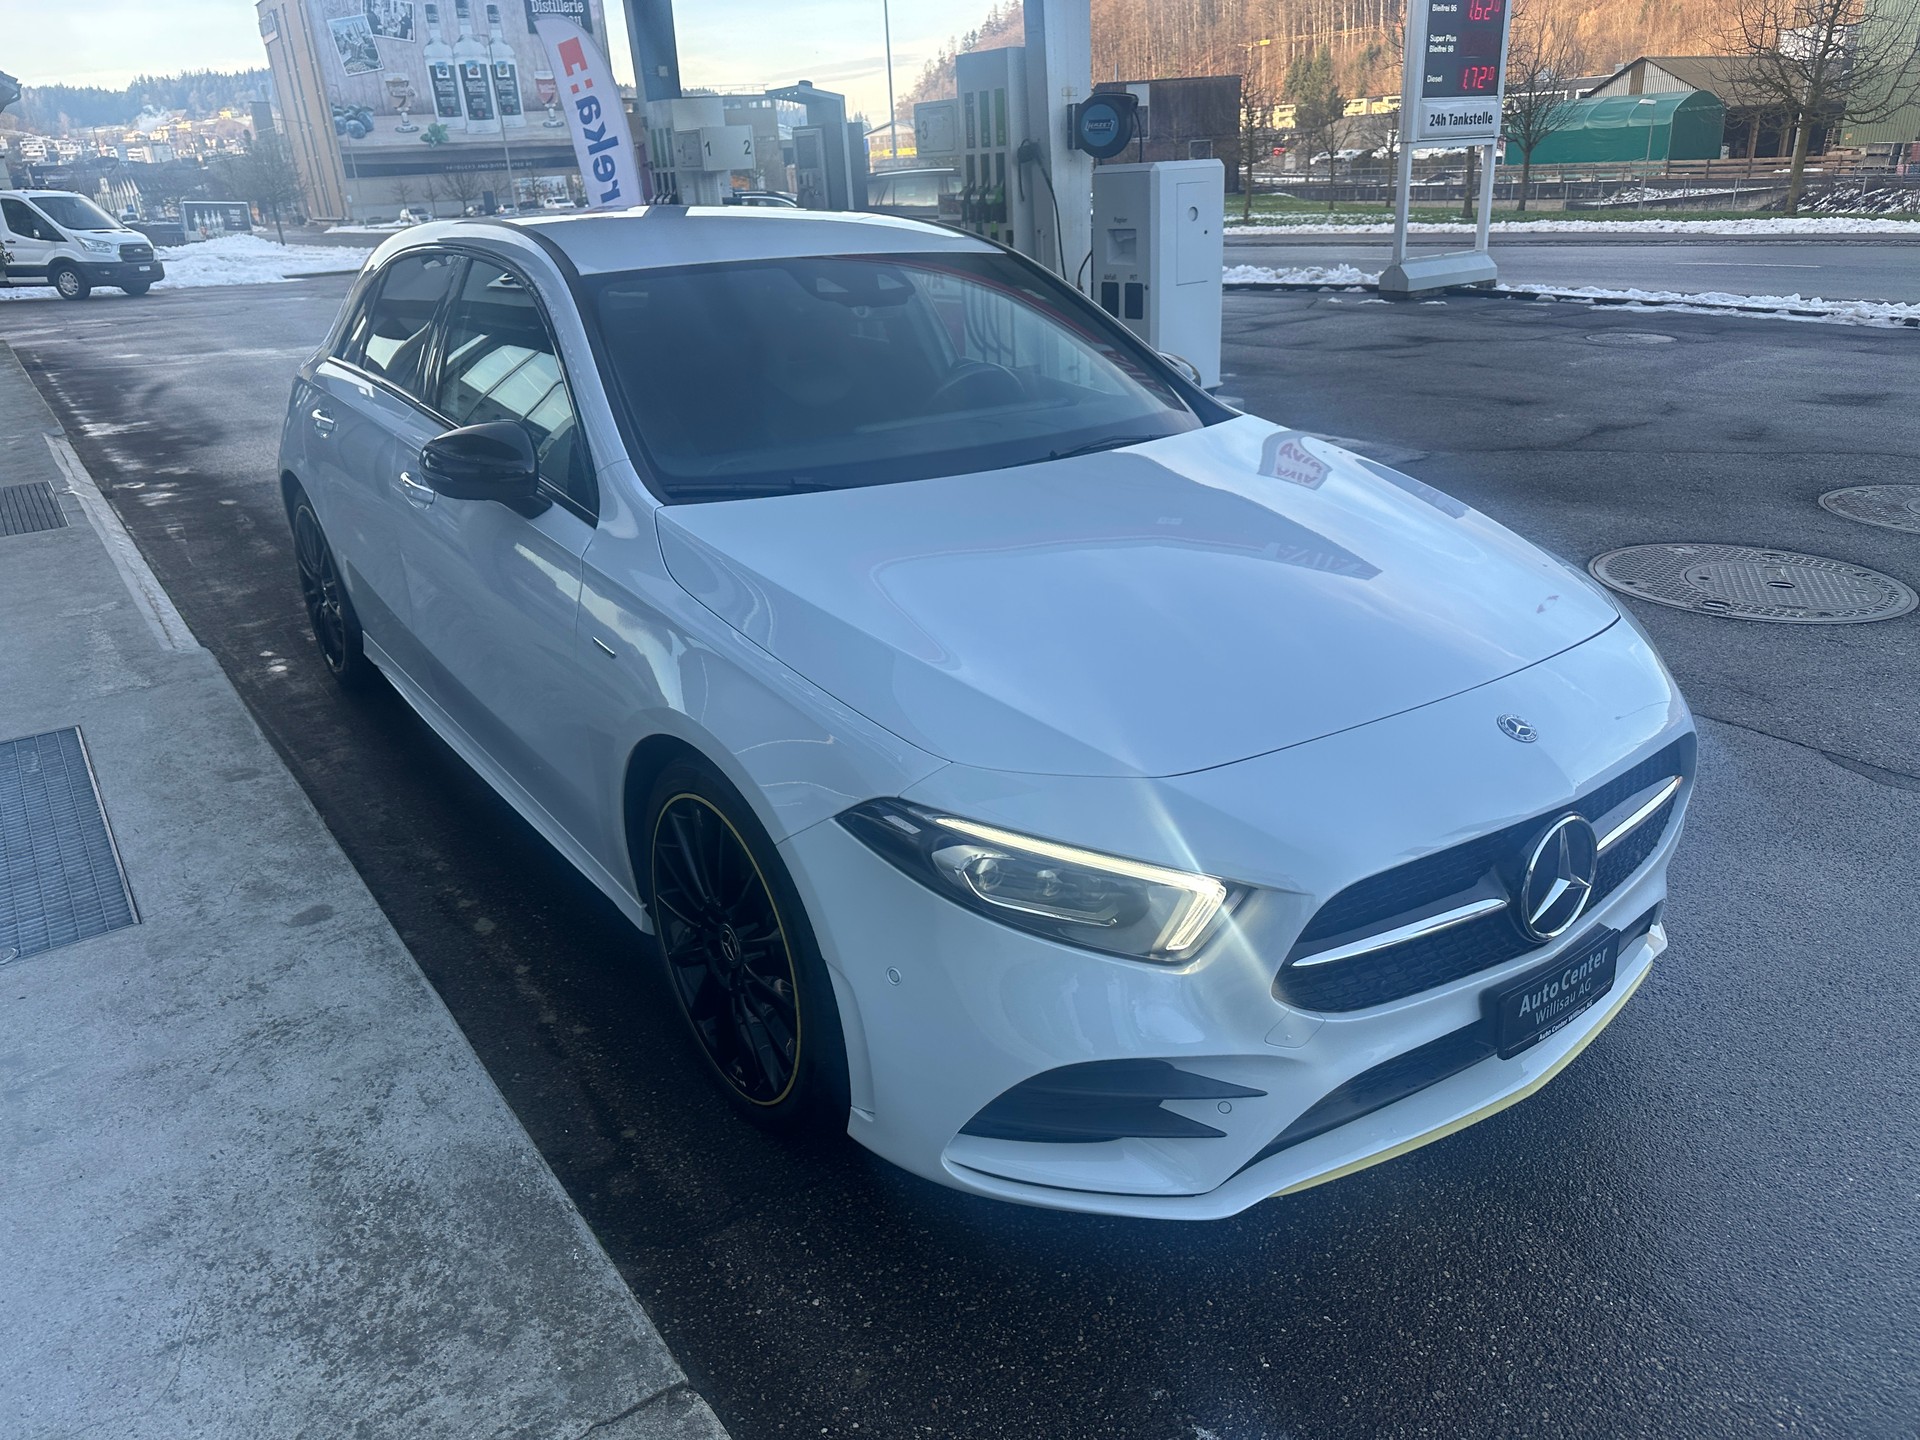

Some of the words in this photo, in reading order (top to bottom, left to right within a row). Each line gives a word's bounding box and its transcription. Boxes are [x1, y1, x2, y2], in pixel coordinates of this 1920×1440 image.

[531, 0, 584, 13] Distillerie
[1432, 4, 1449, 12] Bleifrei
[1429, 34, 1445, 43] Super
[1446, 34, 1457, 42] Plus
[1429, 45, 1446, 53] Bleifrei
[1426, 75, 1443, 83] Diesel
[1429, 113, 1446, 127] 24h
[1449, 111, 1493, 126] Tankstelle
[704, 141, 711, 157] 1
[743, 139, 751, 155] 2
[1518, 981, 1559, 1018] Auto
[1561, 947, 1608, 991] Center
[1535, 993, 1576, 1025] Willisau
[1578, 977, 1592, 997] AG
[1538, 1030, 1551, 1041] Auto
[1551, 1019, 1568, 1032] Center
